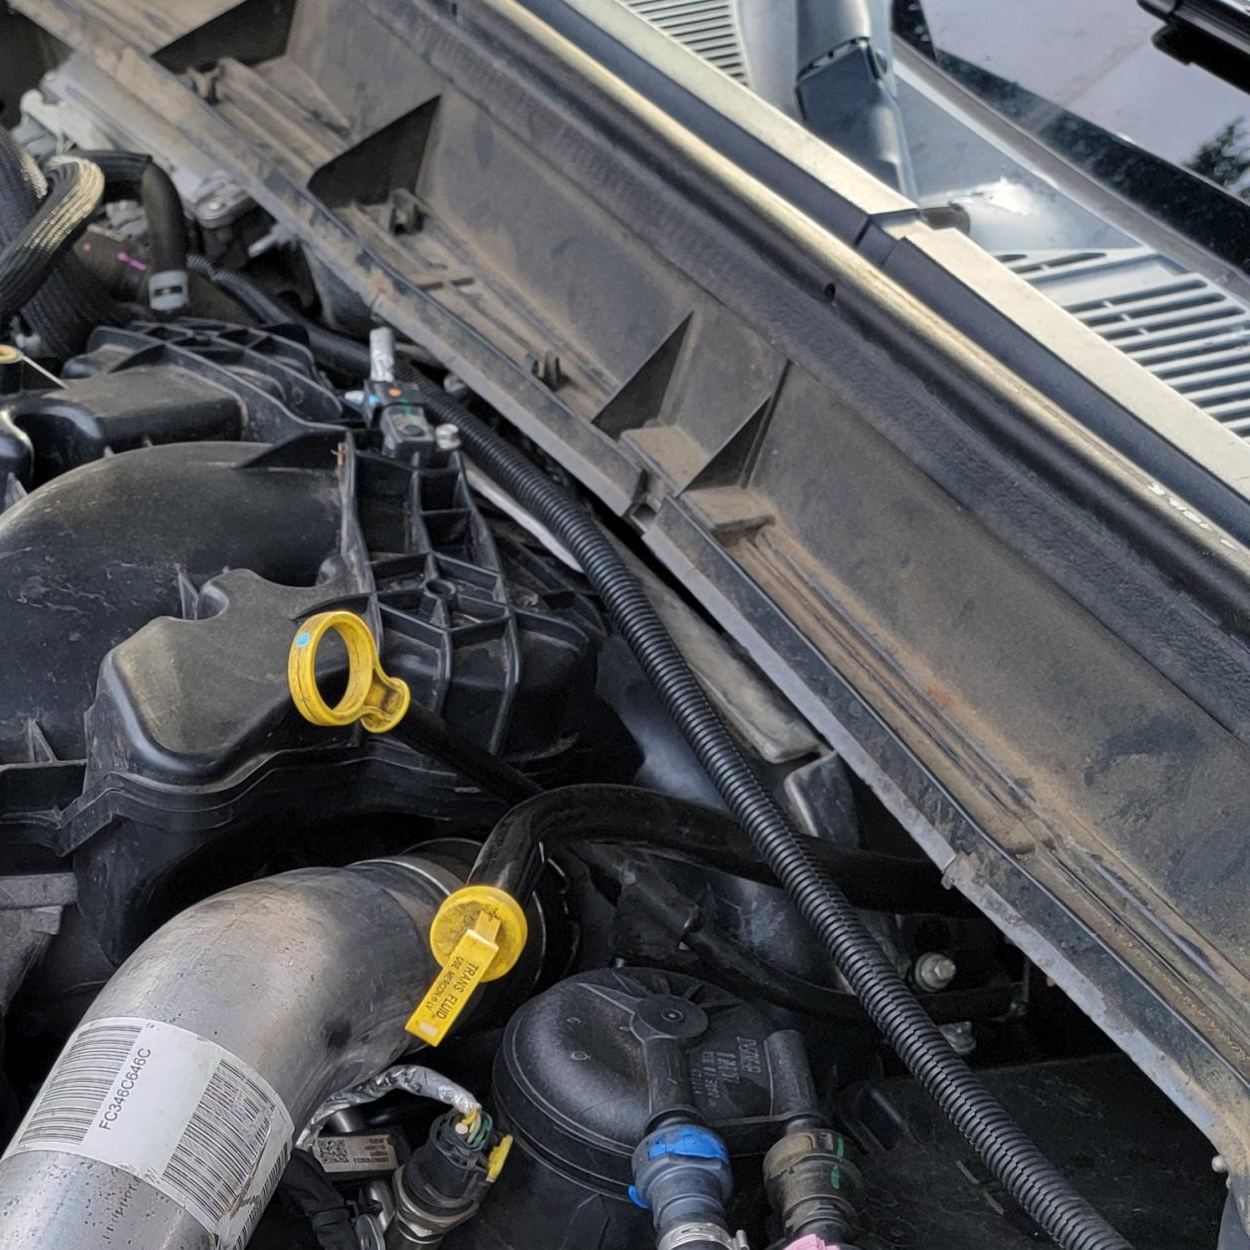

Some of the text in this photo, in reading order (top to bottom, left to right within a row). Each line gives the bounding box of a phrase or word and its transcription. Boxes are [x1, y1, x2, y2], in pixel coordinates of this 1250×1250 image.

[436, 961, 479, 1020] TRANS FLUID
[99, 1047, 152, 1131] FC346C646C
